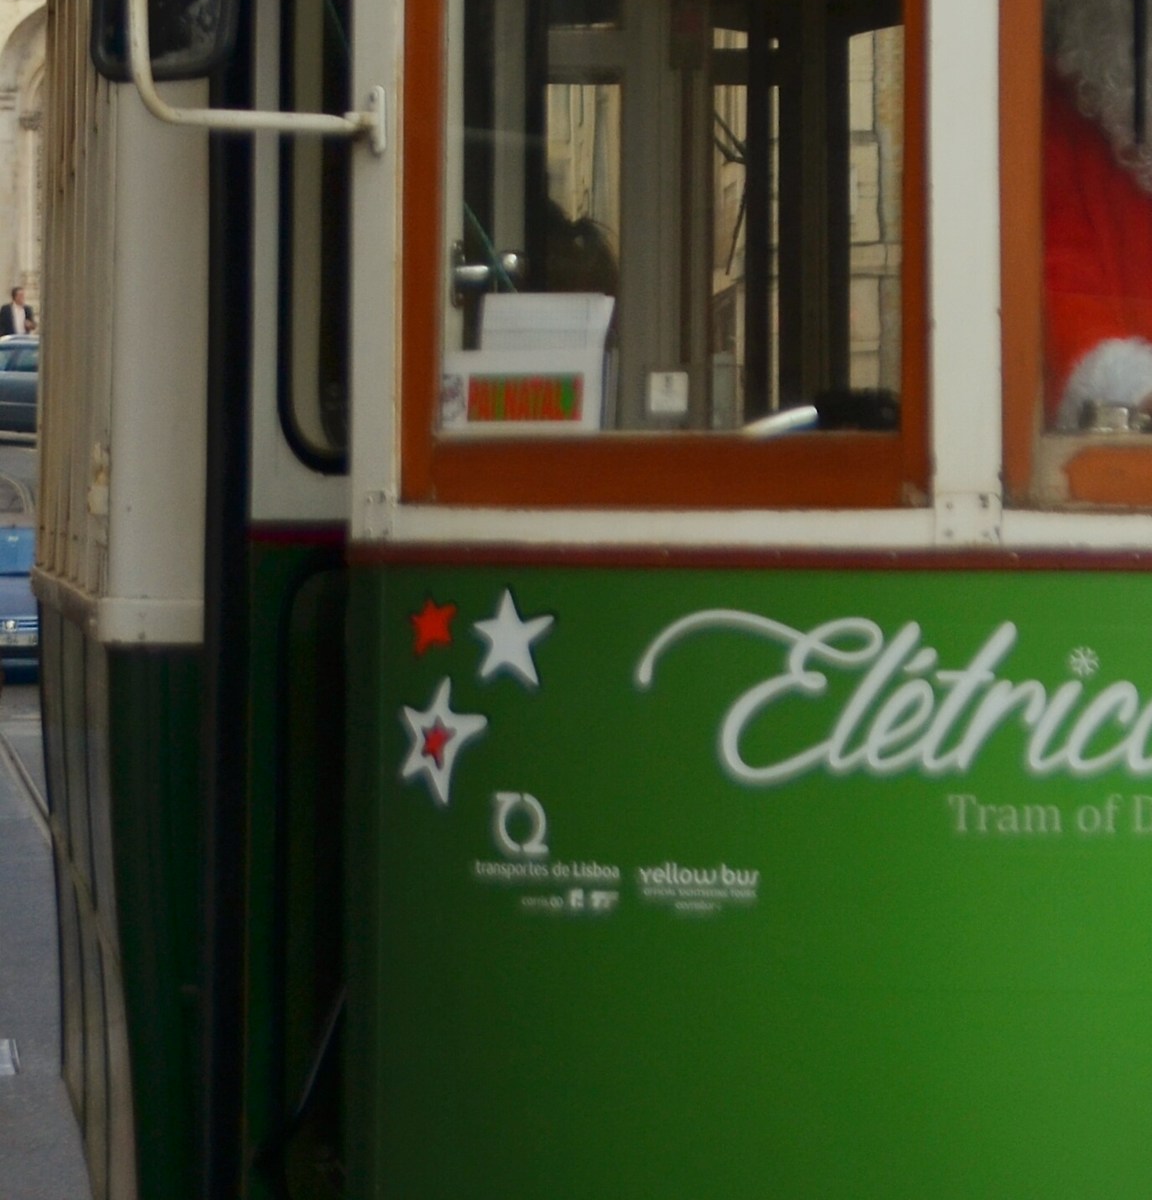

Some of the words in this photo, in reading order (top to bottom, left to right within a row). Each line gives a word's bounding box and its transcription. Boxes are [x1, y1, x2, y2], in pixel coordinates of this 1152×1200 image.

[947, 794, 1063, 834] Tram
[1077, 794, 1121, 834] of
[474, 860, 549, 879] transportes
[552, 861, 570, 877] de
[572, 860, 621, 880] Lisboa
[638, 861, 718, 885] yellow
